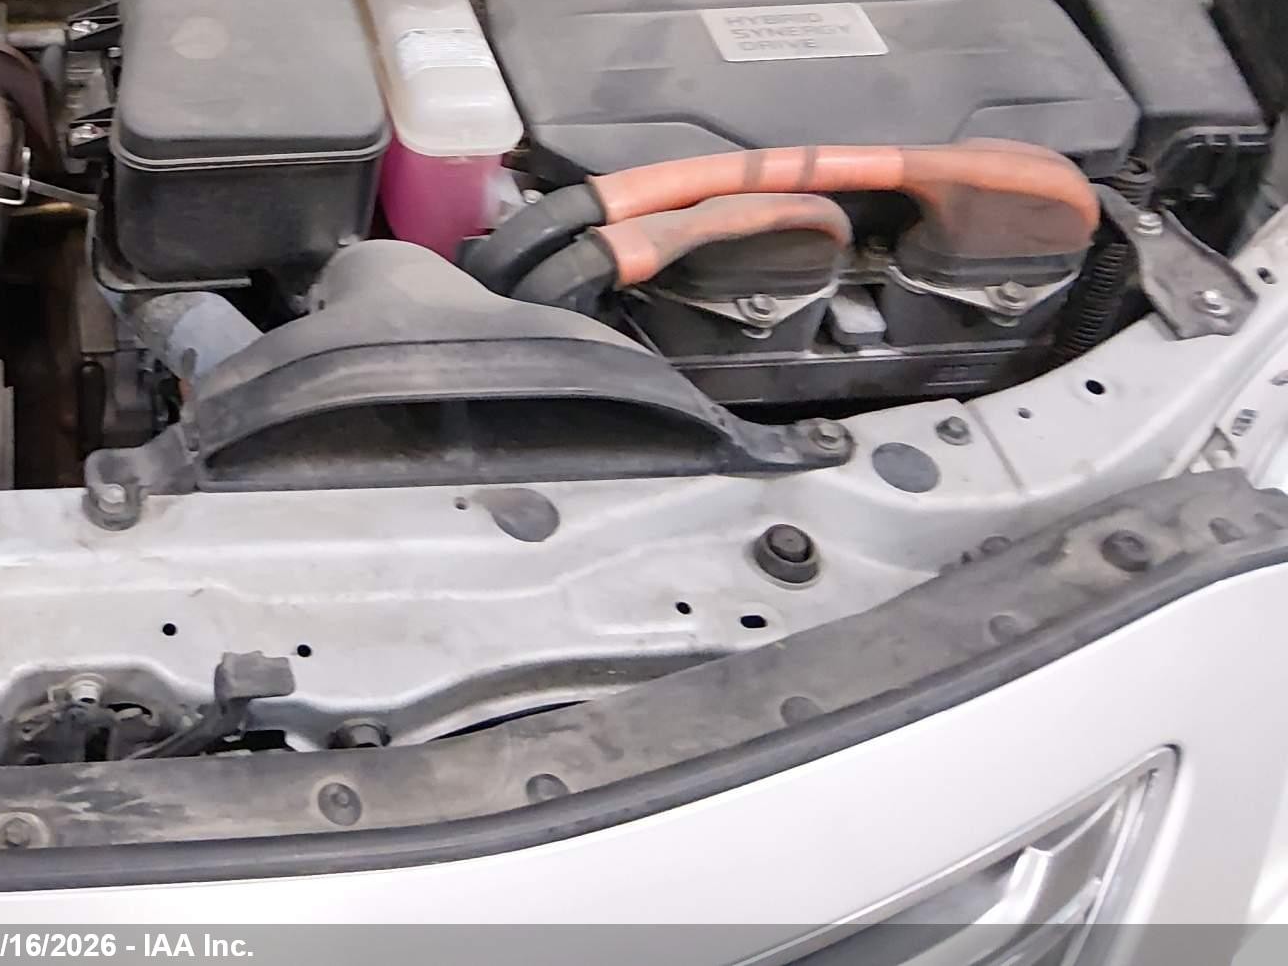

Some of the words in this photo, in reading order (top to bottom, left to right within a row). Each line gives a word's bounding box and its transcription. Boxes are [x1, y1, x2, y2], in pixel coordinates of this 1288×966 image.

[725, 13, 823, 25] HYBRID
[730, 24, 850, 39] SYNERGY
[737, 39, 816, 52] DRIVE
